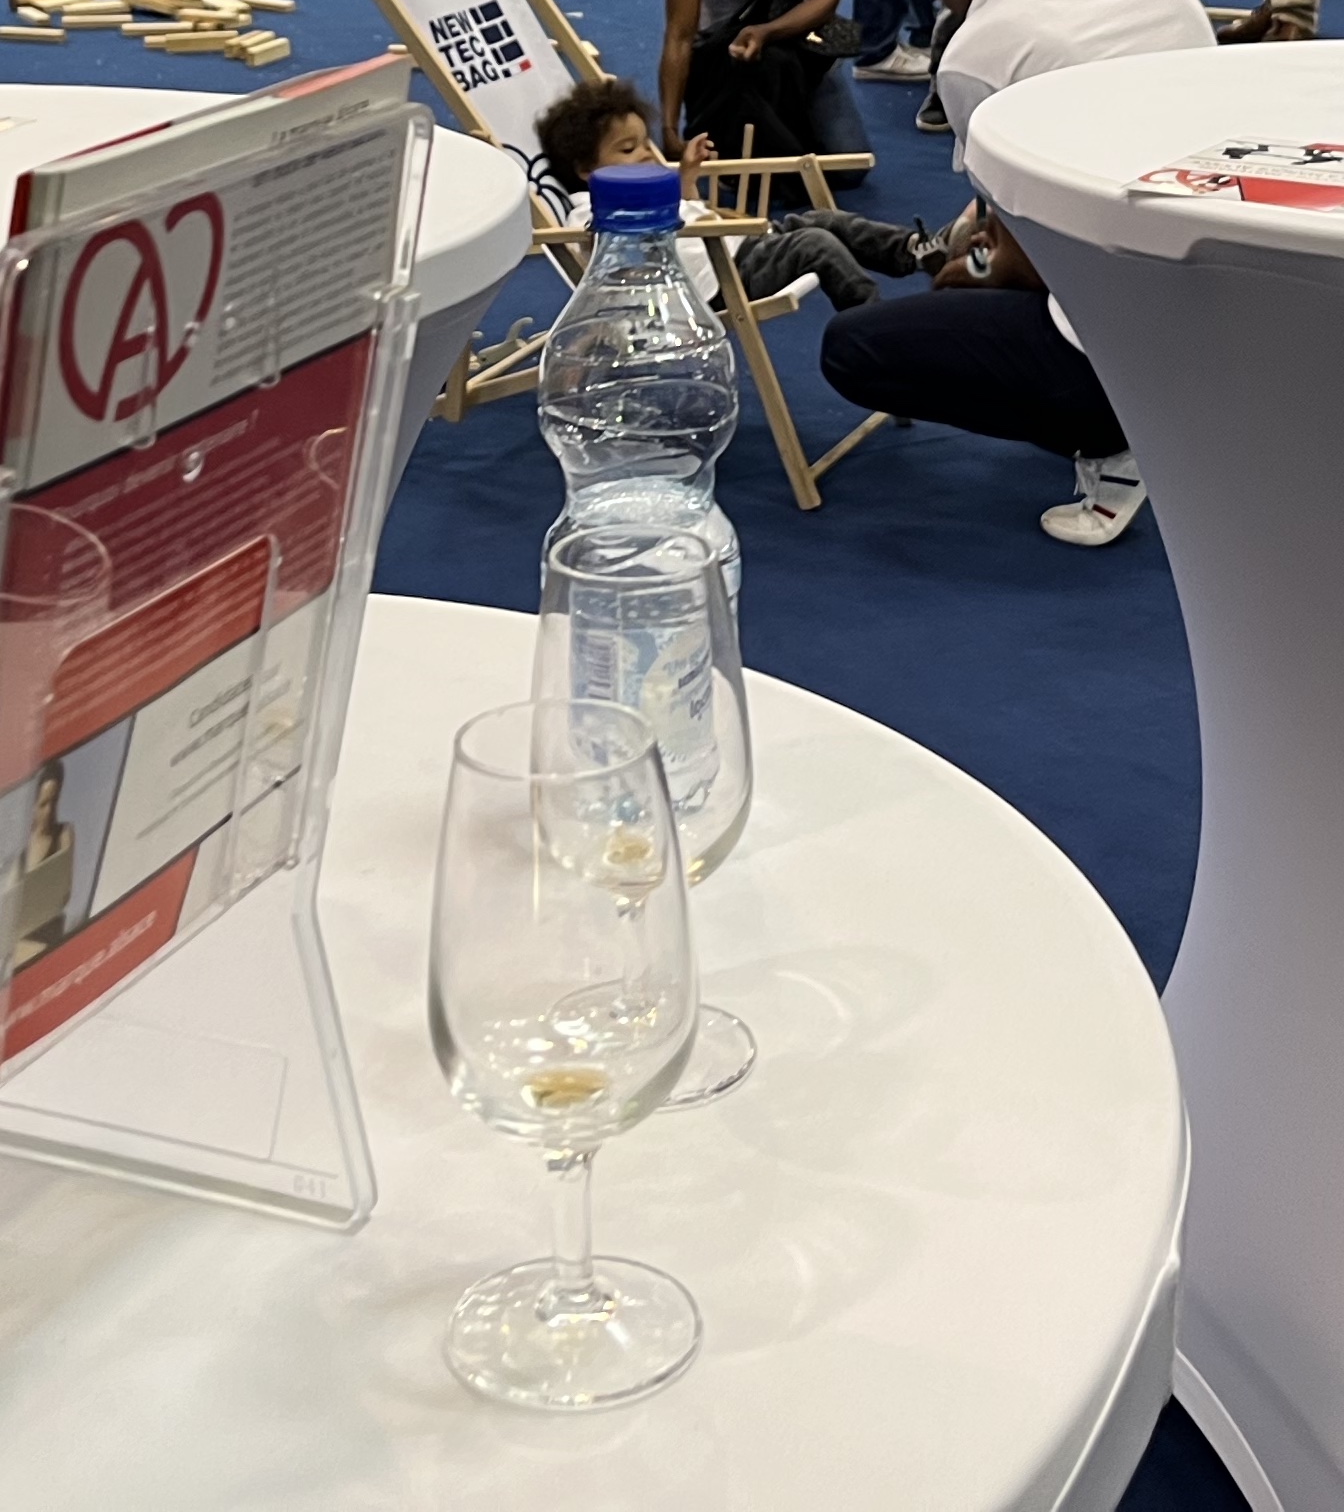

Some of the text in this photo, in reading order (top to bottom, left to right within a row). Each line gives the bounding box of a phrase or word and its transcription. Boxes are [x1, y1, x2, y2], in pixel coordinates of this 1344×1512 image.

[429, 9, 474, 44] NEW
[438, 35, 485, 68] TEC
[451, 59, 501, 93] BAG
